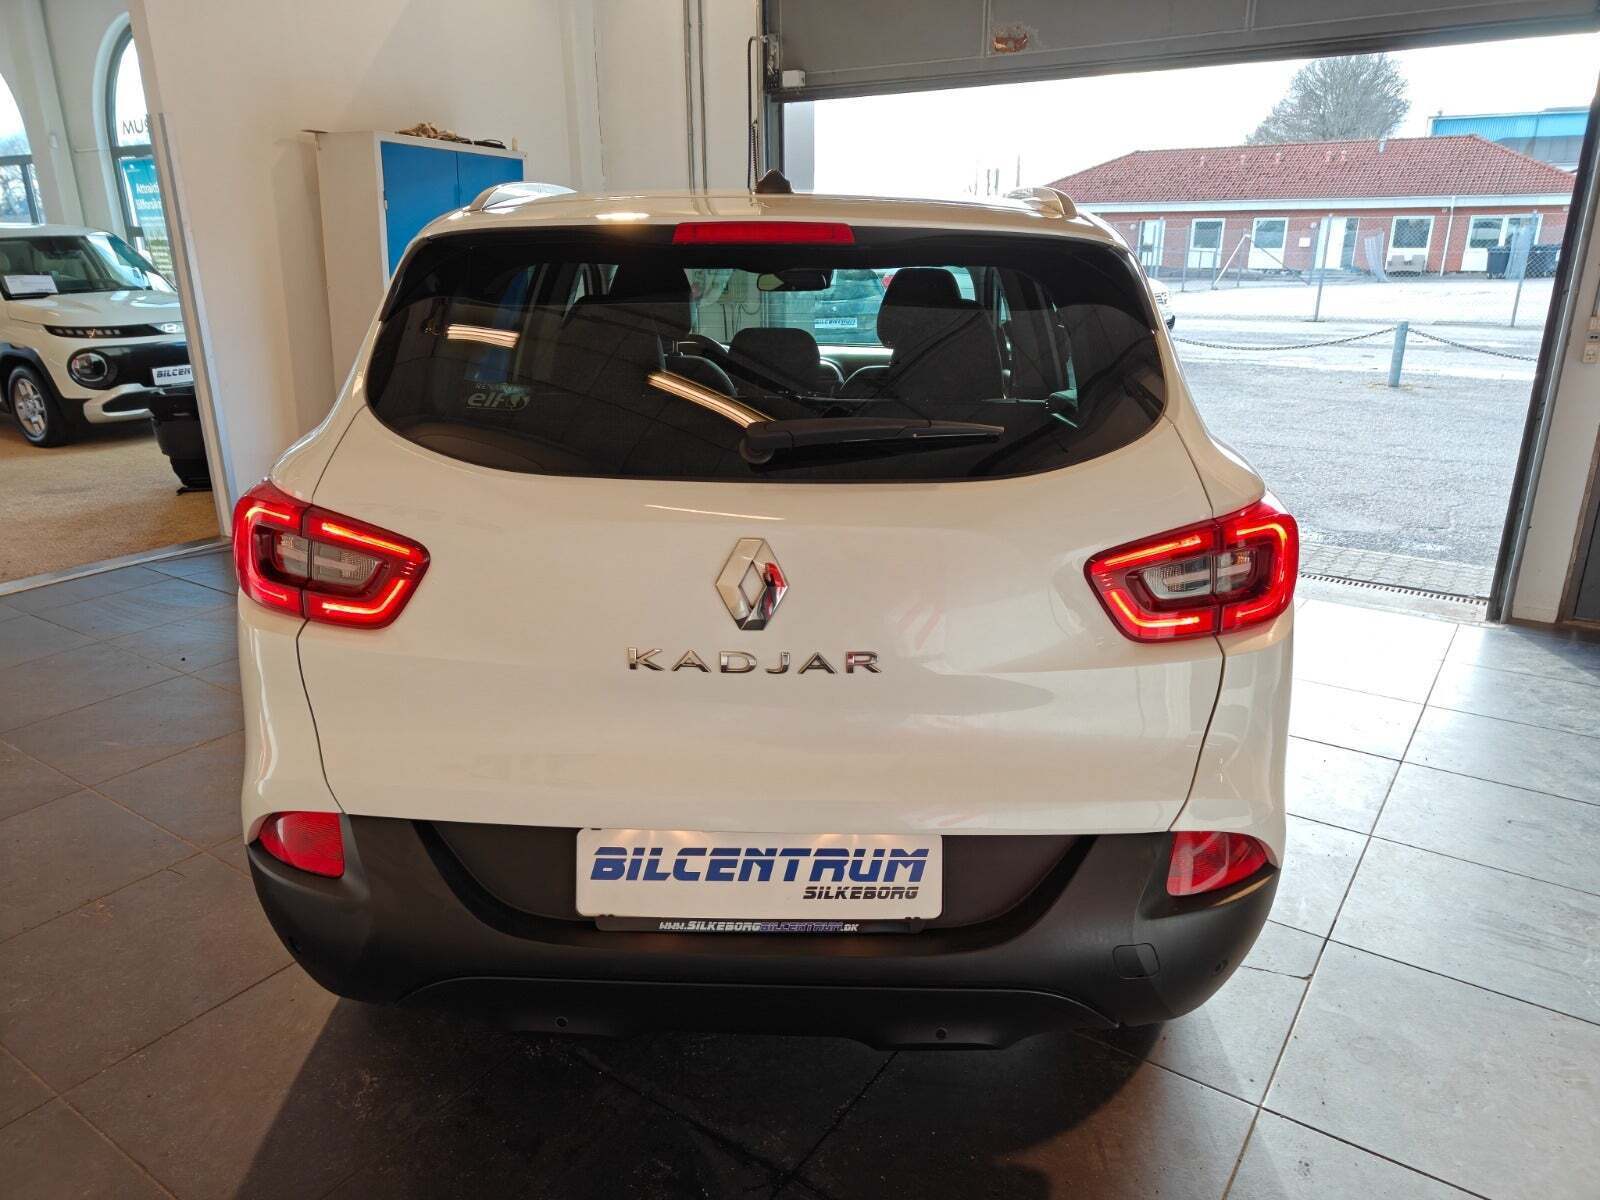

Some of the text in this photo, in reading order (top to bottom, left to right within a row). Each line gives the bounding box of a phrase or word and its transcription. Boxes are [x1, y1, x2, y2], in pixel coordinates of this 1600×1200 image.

[627, 646, 882, 675] KADJAR
[590, 846, 930, 883] BILCENTRUM
[802, 885, 919, 900] SILKEBORG
